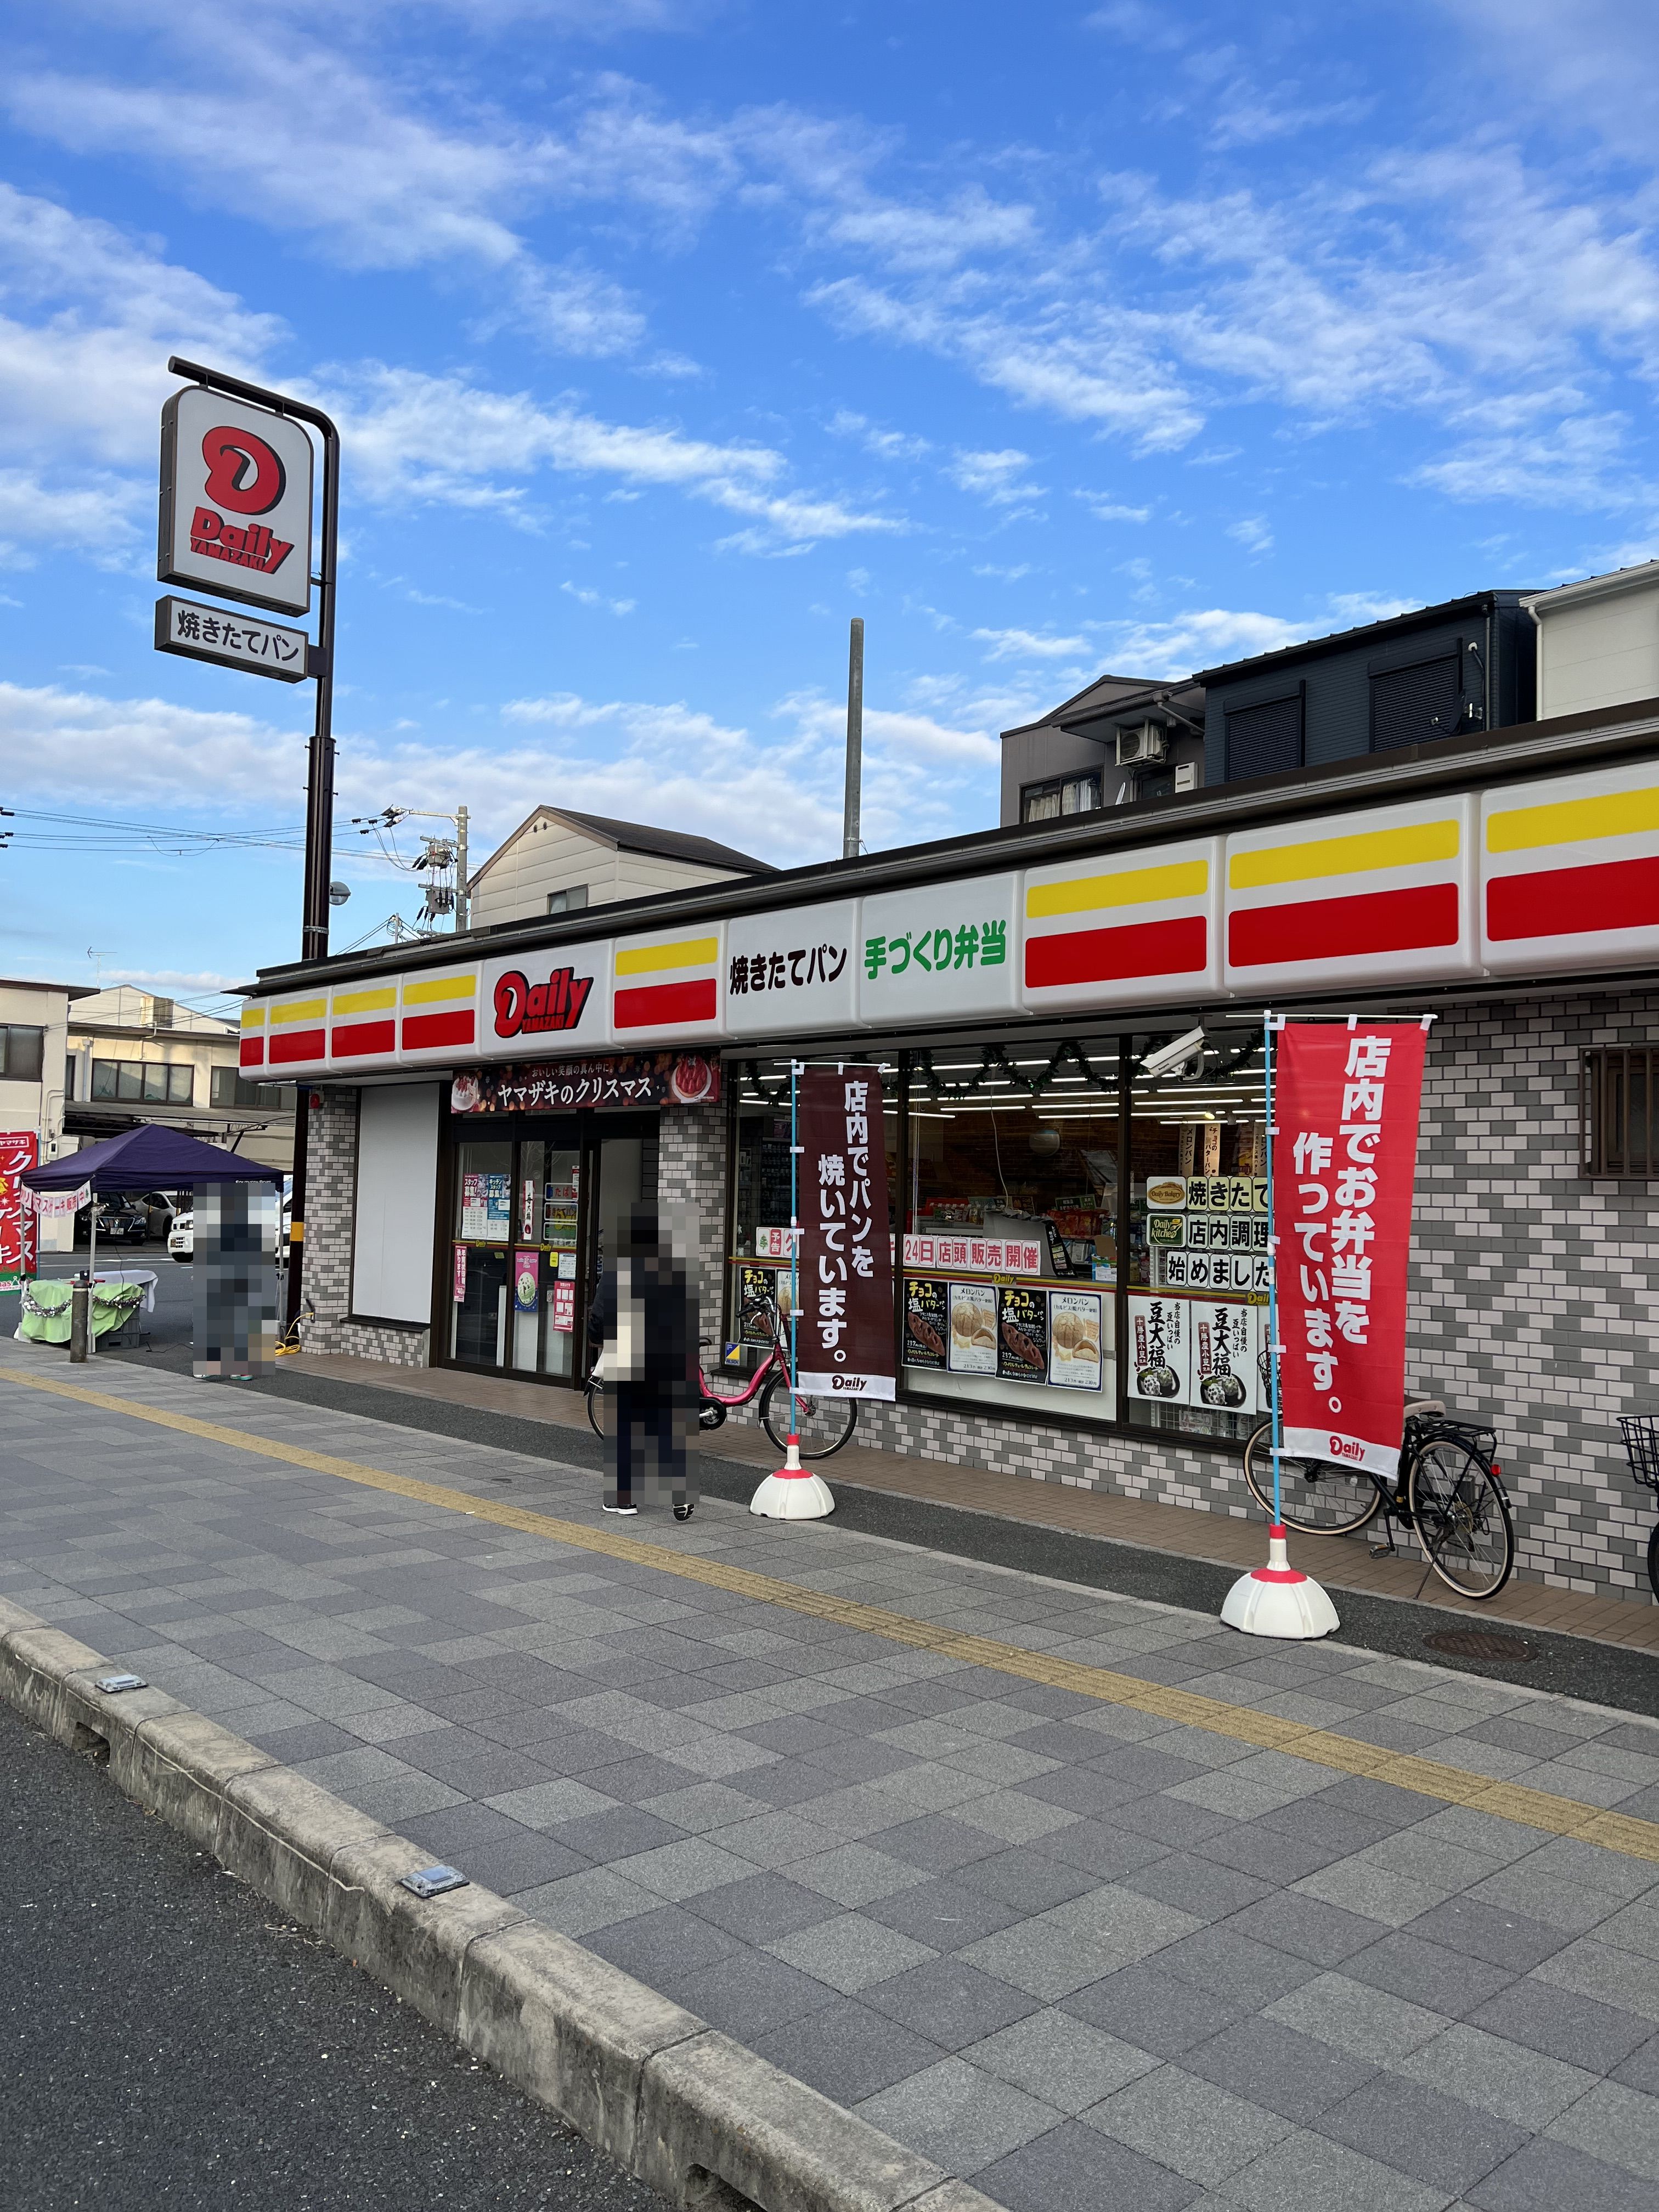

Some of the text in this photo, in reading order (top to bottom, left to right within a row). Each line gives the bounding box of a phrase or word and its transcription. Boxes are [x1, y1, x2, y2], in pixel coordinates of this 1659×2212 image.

[190, 506, 295, 574] Daily
[190, 537, 267, 572] YAMAZAKI
[178, 610, 299, 662] 焼きたてパン
[864, 919, 1006, 980] 手づくり弁当
[730, 943, 848, 995] 焼きたてパン
[494, 967, 594, 1038] Daily
[521, 1014, 565, 1032] YAMAZAKI
[532, 1063, 613, 1077] おいしい笑顔の真ん中に。
[498, 1077, 651, 1107] ヤマザキのクリスマス
[1184, 1128, 1193, 1165] メロンパン
[844, 1081, 874, 1277] 店内でパンを
[1331, 1036, 1392, 1344] 店内でお弁当を
[1188, 1182, 1268, 1207] 焼きたて
[1154, 1219, 1171, 1231] Daily
[1189, 1220, 1268, 1248] 店内調理
[771, 1232, 780, 1252] 予告
[817, 1154, 847, 1362] 焼いています。
[1169, 1256, 1269, 1286] 始めました
[1293, 1132, 1341, 1413] 作っています。
[744, 1269, 768, 1284] チョコの
[909, 1282, 937, 1299] チョコの
[994, 1273, 1014, 1284] Daily
[1005, 1290, 1035, 1308] チョコの
[1062, 1297, 1089, 1305] メロンパン
[1248, 1292, 1269, 1305] Dail
[1148, 1301, 1166, 1369] 豆大福
[1212, 1307, 1232, 1378] 豆大福
[832, 1375, 867, 1391] Daily
[1330, 1436, 1365, 1462] Daily
